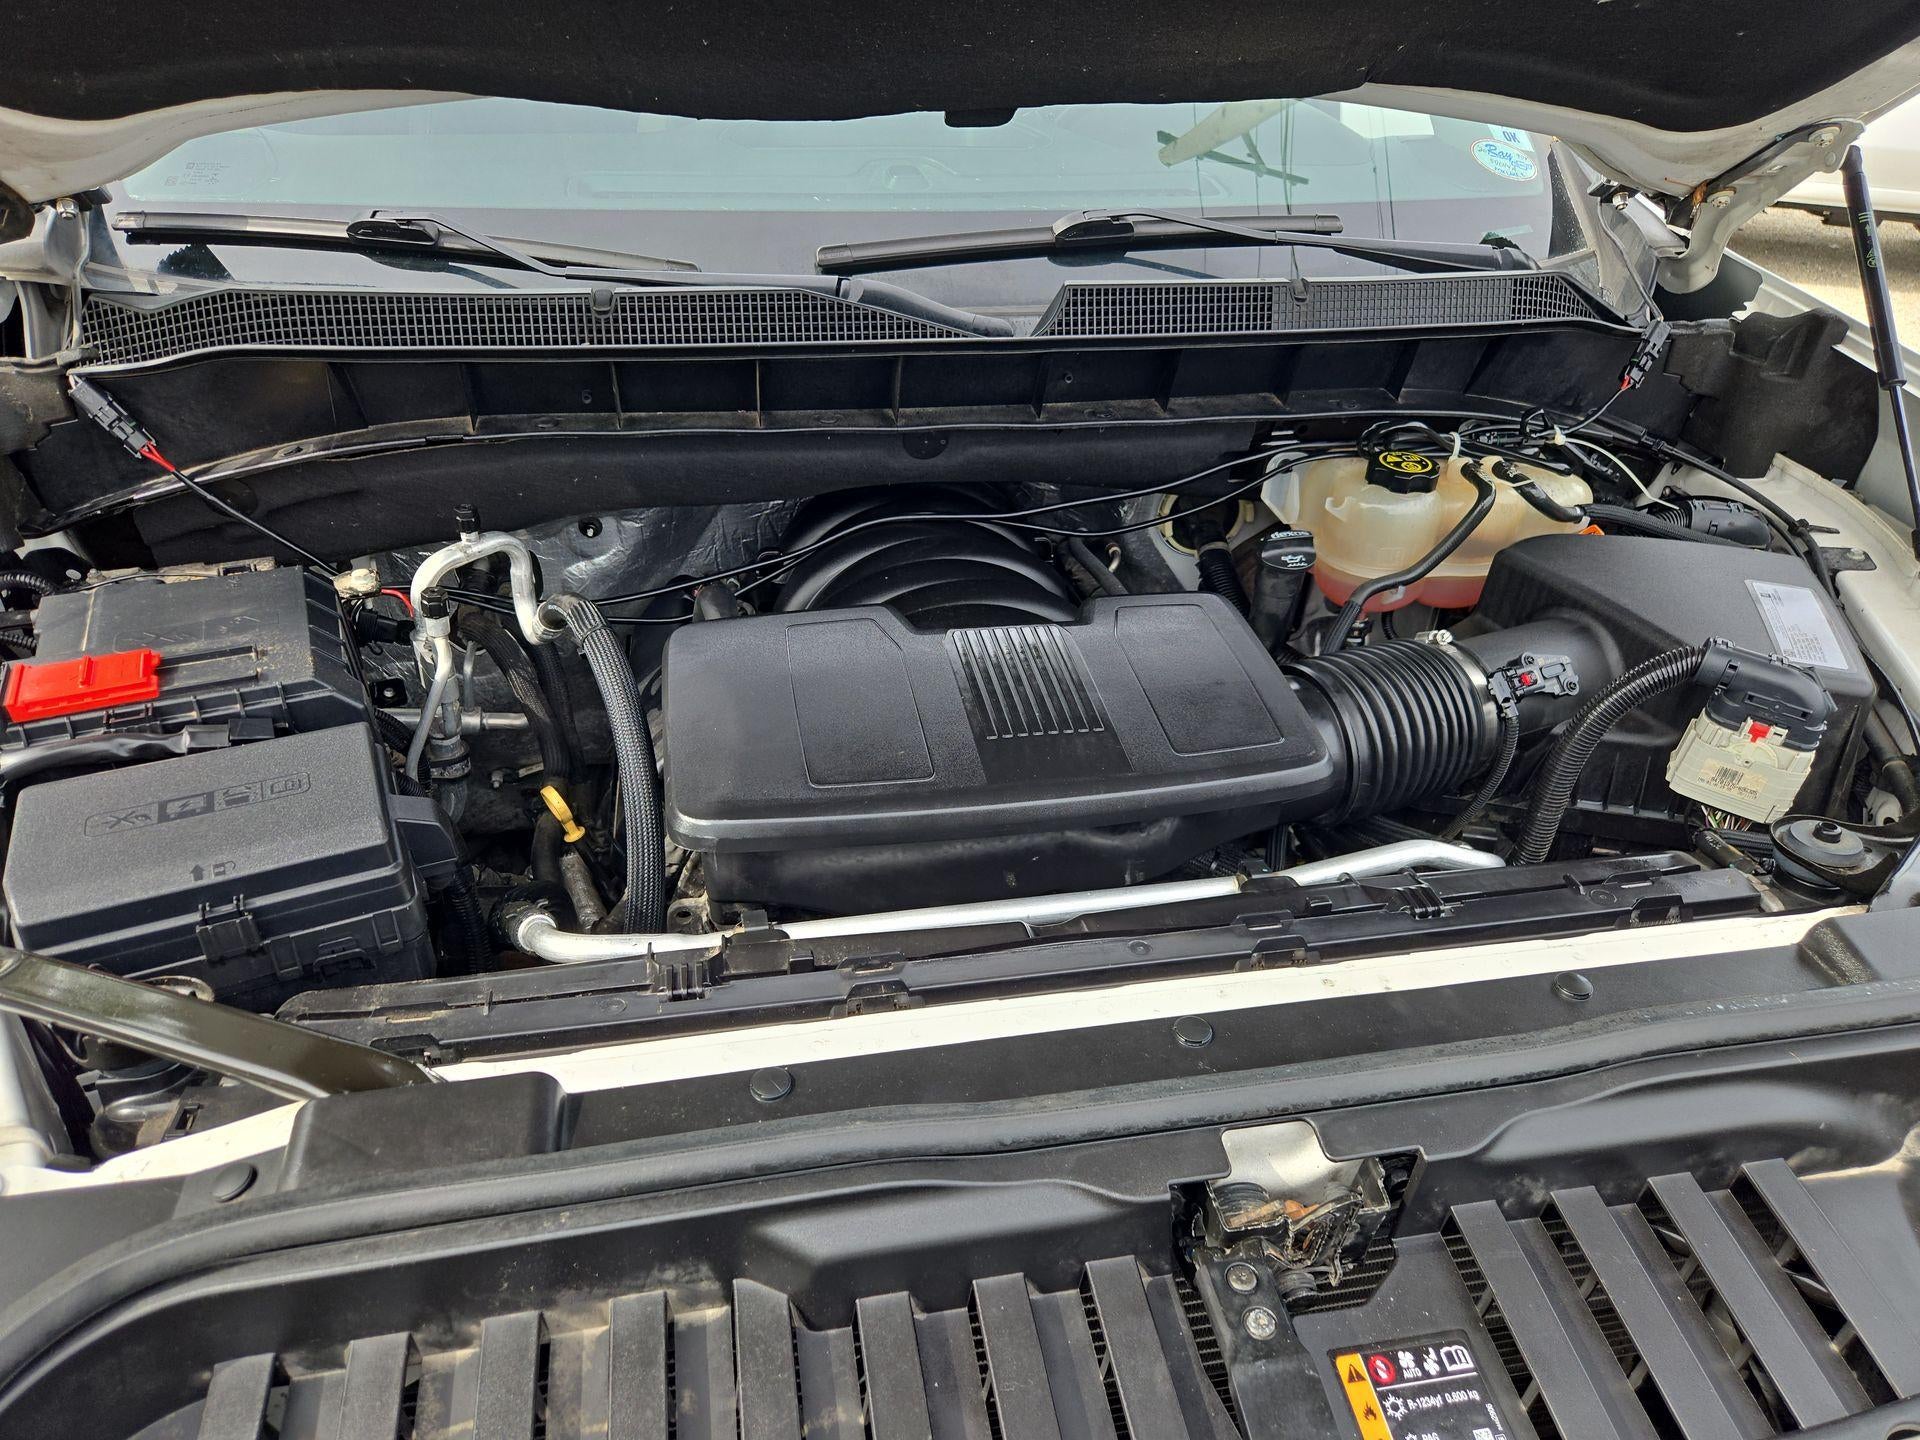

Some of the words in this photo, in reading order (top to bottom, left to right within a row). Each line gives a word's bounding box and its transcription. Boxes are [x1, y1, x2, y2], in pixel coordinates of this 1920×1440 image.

[1502, 130, 1521, 144] OK
[1270, 531, 1310, 539] dexos
[1402, 1367, 1422, 1380] AUTO
[1407, 1394, 1444, 1411] R-1234yf
[1467, 1389, 1480, 1401] kg
